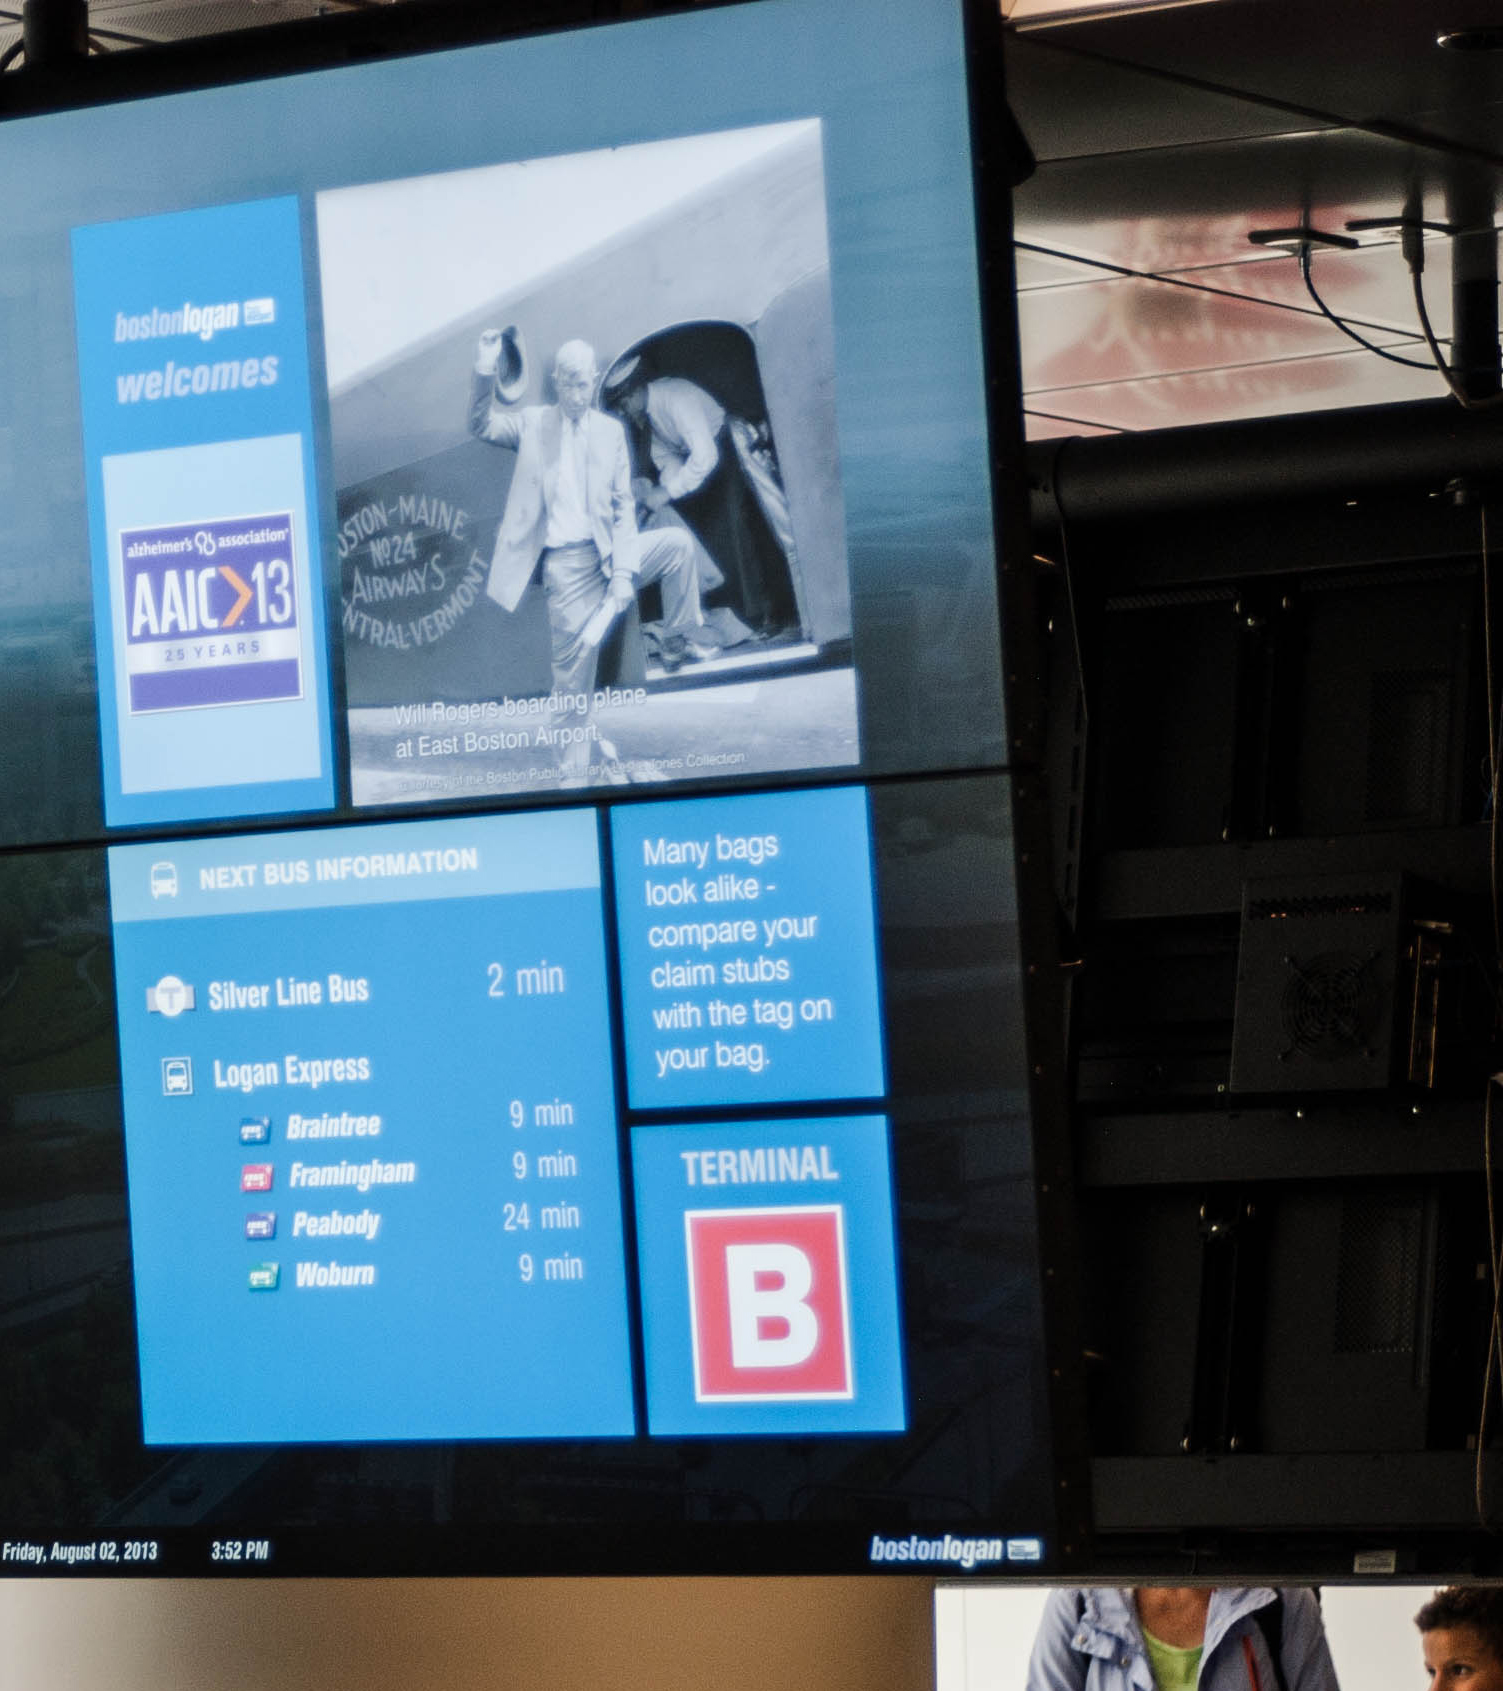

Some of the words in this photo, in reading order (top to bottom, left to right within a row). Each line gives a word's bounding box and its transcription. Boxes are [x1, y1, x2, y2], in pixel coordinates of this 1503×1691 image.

[114, 302, 239, 342] bostonlogan
[116, 355, 280, 404] welcomes
[127, 537, 193, 558] alzheimer's
[352, 553, 446, 604] AIRWAYS
[164, 649, 185, 662] 25
[194, 640, 260, 658] YEARS
[393, 703, 427, 726] Will
[433, 701, 498, 726] Rogers
[503, 690, 588, 718] boarding
[595, 686, 647, 710] plane
[396, 737, 414, 759] at
[418, 734, 459, 757] East
[464, 728, 529, 754] Boston
[643, 838, 709, 869] Many
[715, 834, 779, 865] bags
[200, 865, 257, 890] NEXT
[264, 860, 310, 886] BUS
[316, 848, 478, 881] INFORMATION
[645, 878, 697, 906] look
[703, 874, 759, 903] alike
[648, 919, 757, 951] compare
[762, 915, 818, 948] your
[487, 962, 505, 997] 2
[516, 960, 564, 995] min
[651, 960, 716, 988] claim
[722, 955, 790, 984] stubs
[208, 981, 270, 1011] Silver
[276, 977, 322, 1006] Line
[328, 974, 369, 1003] Bus
[653, 1001, 701, 1030] with
[708, 1000, 747, 1026] the
[753, 999, 794, 1030] tag
[800, 998, 832, 1021] on
[214, 1059, 278, 1092] Logan
[285, 1055, 370, 1088] Express
[655, 1046, 709, 1077] your
[715, 1041, 771, 1073] bag.
[286, 1112, 381, 1140] Braintree
[509, 1100, 524, 1128] 9
[535, 1098, 574, 1127] min
[290, 1158, 415, 1192] Framingham
[513, 1151, 527, 1180] 9
[538, 1150, 577, 1178] min
[680, 1146, 839, 1186] TERMINAL
[292, 1209, 381, 1240] Peabody
[503, 1203, 530, 1231] 24
[541, 1201, 580, 1229] min
[296, 1261, 375, 1287] Woburn
[519, 1254, 534, 1282] 9
[545, 1252, 583, 1280] min
[726, 1243, 819, 1368] B
[2, 1541, 47, 1564] Friday,
[50, 1541, 96, 1564] August
[99, 1541, 121, 1563] 02,
[124, 1541, 158, 1560] 2013
[211, 1541, 242, 1560] 3:52
[246, 1540, 269, 1560] PM
[870, 1534, 1003, 1568] bostonlogan
